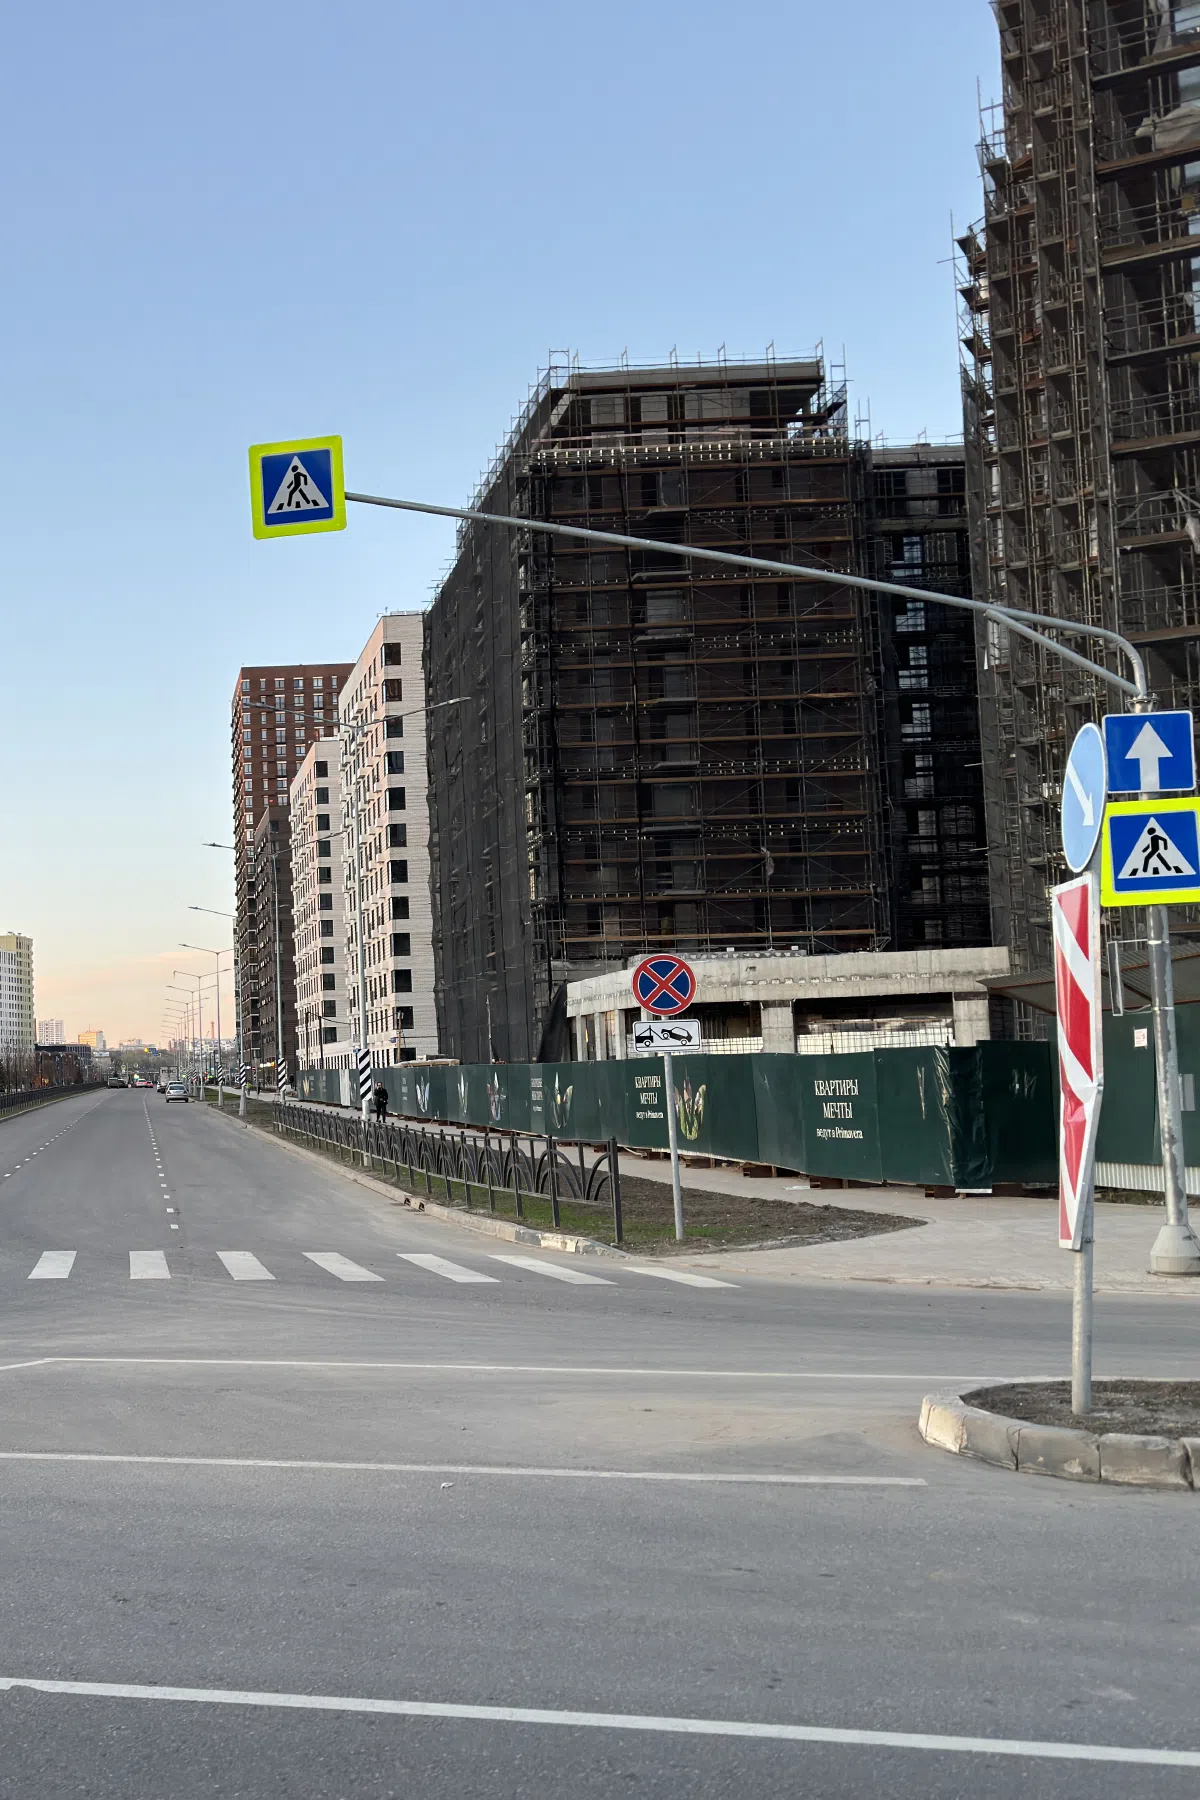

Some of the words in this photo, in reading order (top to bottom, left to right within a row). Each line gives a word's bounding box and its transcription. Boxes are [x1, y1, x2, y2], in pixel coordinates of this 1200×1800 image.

[814, 1079, 859, 1096] КВАРТИРЫ
[822, 1102, 853, 1119] МЕЧТЫ
[816, 1128, 832, 1141] ведут
[835, 1126, 864, 1139] Primavera
